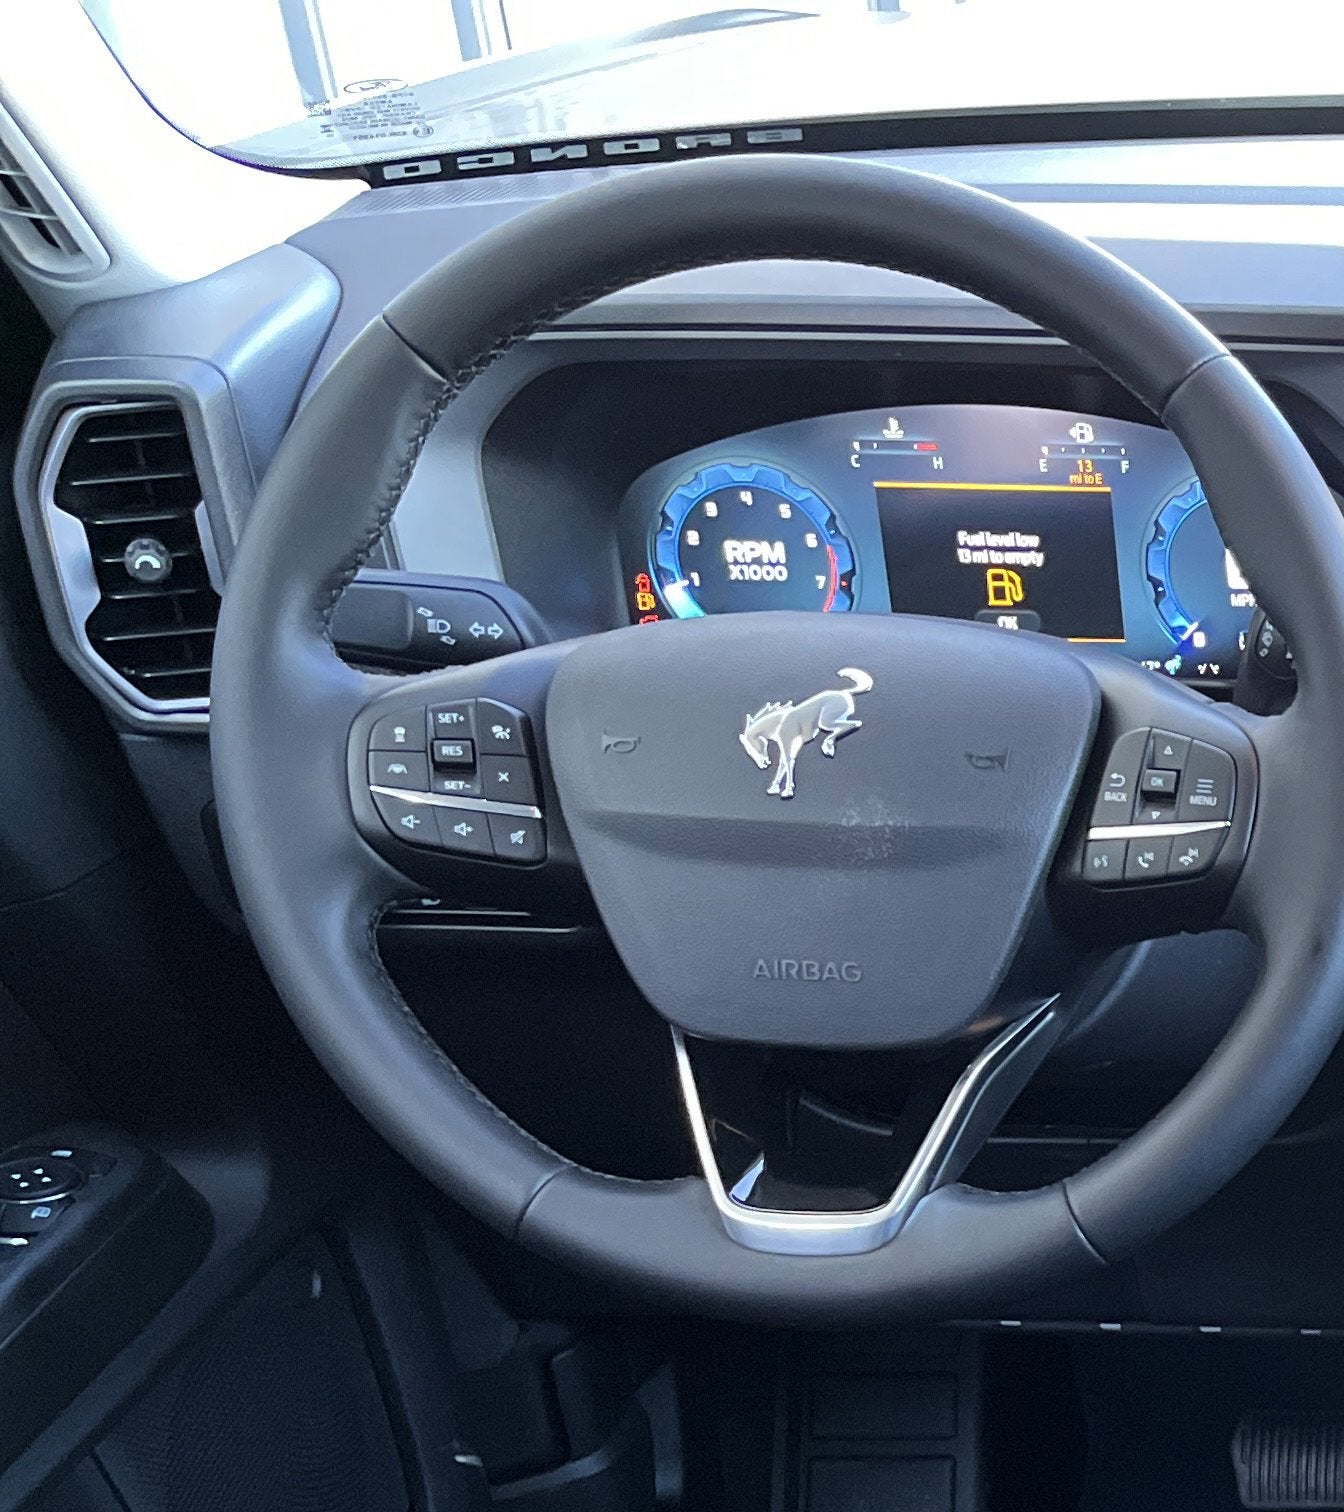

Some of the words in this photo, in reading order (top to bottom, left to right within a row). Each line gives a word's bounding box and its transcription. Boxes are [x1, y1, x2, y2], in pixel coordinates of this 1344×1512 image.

[850, 454, 860, 468] C
[933, 456, 943, 470] H
[1039, 458, 1048, 473] E
[1077, 460, 1094, 473] 13
[1120, 460, 1130, 474] F
[740, 491, 752, 506] 4
[705, 502, 718, 517] 3
[779, 503, 791, 519] 5
[687, 530, 700, 546] 2
[805, 534, 818, 548] 6
[957, 530, 985, 546] Fuel
[985, 531, 1015, 547] level
[1016, 532, 1040, 547] low
[723, 539, 786, 564] RPM
[989, 550, 1004, 564] to
[1004, 550, 1044, 567] empty
[691, 572, 700, 587] 1
[729, 565, 787, 581] X1000
[815, 575, 826, 589] 7
[441, 746, 463, 756] RES
[1151, 777, 1164, 787] OK
[1104, 791, 1127, 802] BACK
[1189, 795, 1217, 806] MENU
[753, 958, 862, 982] AIRBAG
